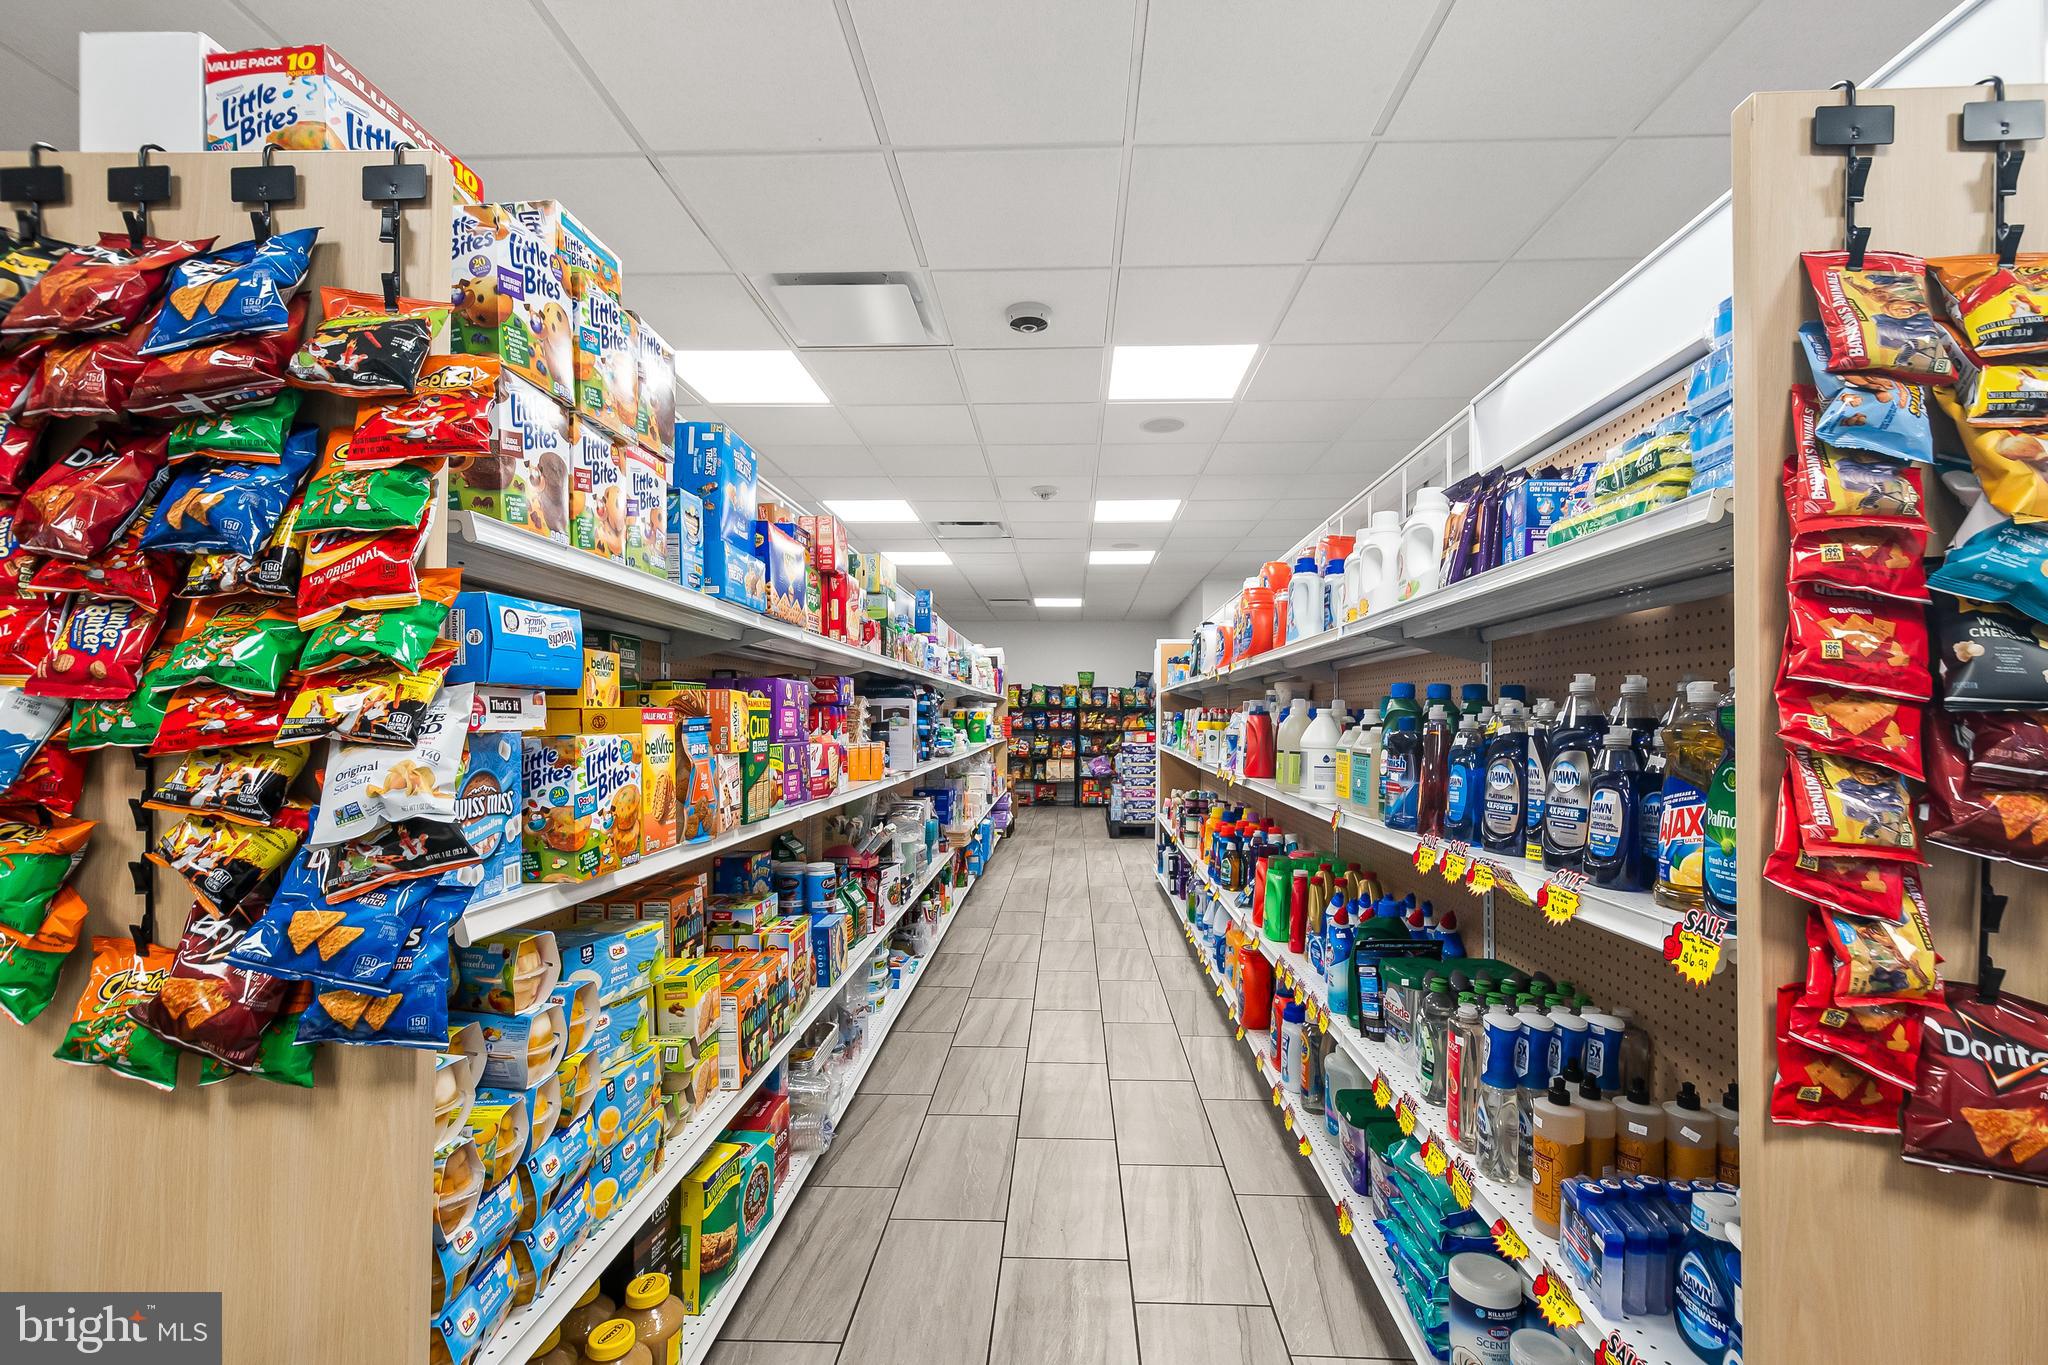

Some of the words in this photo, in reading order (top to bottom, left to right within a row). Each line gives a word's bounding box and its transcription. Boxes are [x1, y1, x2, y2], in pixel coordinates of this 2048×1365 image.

[208, 59, 247, 73] VALUE
[248, 55, 283, 69] PACK
[287, 51, 317, 71] 10
[222, 84, 277, 131] Little
[327, 50, 399, 121] VALUE
[402, 119, 452, 162] PACK
[240, 105, 298, 145] Bites
[452, 160, 478, 194] 10
[510, 233, 548, 270] Little
[564, 236, 583, 253] Little
[472, 258, 487, 268] 20
[570, 252, 590, 270] Bites
[524, 267, 561, 301] Bites
[1826, 271, 1848, 308] ANIMALS
[244, 297, 262, 306] 150
[590, 298, 620, 327] Little
[600, 326, 628, 351] Bites
[1838, 306, 1865, 358] BARNUM'S
[524, 424, 558, 450] Bites
[1802, 408, 1814, 449] ANIMALS
[583, 436, 609, 466] Little
[592, 461, 618, 485] Bites
[633, 472, 653, 495] Little
[640, 492, 660, 510] Bites
[223, 520, 239, 531] 150
[1998, 535, 2042, 555] Vinegar
[2002, 527, 2021, 538] Sea
[2023, 532, 2043, 546] Salt
[264, 562, 280, 572] 160
[325, 546, 379, 580] ORIGINAL
[83, 604, 110, 654] Butter
[103, 602, 135, 648] Nutter
[524, 617, 547, 628] Snacks
[591, 656, 615, 670] belVita
[491, 699, 507, 712] That's
[508, 699, 519, 711] it
[392, 714, 407, 723] 160
[750, 715, 769, 740] CLUB
[645, 733, 674, 756] belVita
[420, 749, 441, 762] 140
[650, 756, 671, 765] CRUNCHY
[335, 761, 379, 783] Original
[586, 743, 619, 787] Little
[333, 781, 349, 796] Sea
[350, 775, 372, 790] Salt
[530, 765, 573, 791] Bites
[599, 765, 630, 801] Bites
[1488, 771, 1514, 785] DAWN
[1552, 770, 1581, 787] DAWN
[552, 789, 565, 797] 20
[1488, 793, 1513, 801] PLATINUM
[1551, 796, 1579, 805] PLATINUM
[455, 796, 485, 821] WISS
[1487, 801, 1495, 809] 4X
[1495, 802, 1515, 812] POWER
[1549, 806, 1558, 815] 4X
[1558, 808, 1580, 819] POWER
[1591, 802, 1613, 815] DAWN
[1659, 805, 1705, 847] AJAX
[1707, 808, 1736, 830] Palmo
[1422, 833, 1441, 850] SALE
[1448, 840, 1471, 858] SALE
[1723, 858, 1728, 868] &
[1551, 868, 1590, 893] SALE
[1682, 908, 1728, 944] SALE
[582, 946, 593, 957] 12
[612, 946, 625, 957] Dole
[360, 956, 378, 967] 150
[610, 963, 628, 974] diced
[610, 971, 629, 985] pears
[552, 996, 564, 1006] Dole
[1382, 997, 1411, 1022] ascade
[411, 1017, 427, 1026] 150
[594, 1033, 610, 1047] diced
[1518, 1042, 1527, 1057] 5X
[1551, 1042, 1560, 1057] 5X
[1589, 1043, 1602, 1058] 5X
[1944, 1027, 2048, 1075] Dorito
[607, 1082, 614, 1093] 12
[626, 1076, 636, 1089] Dole
[562, 1140, 575, 1154] diced
[624, 1142, 635, 1157] Dole
[545, 1158, 558, 1172] Dole
[603, 1154, 611, 1166] 12
[1453, 1154, 1477, 1187] SALE
[573, 1187, 583, 1199] added
[479, 1206, 494, 1224] diced
[481, 1210, 503, 1234] peaches
[560, 1210, 572, 1226] diced
[457, 1229, 473, 1250] Dole
[527, 1235, 533, 1244] 4
[542, 1230, 555, 1247] Dole
[480, 1285, 494, 1303] diced
[1682, 1271, 1713, 1305] DAWN
[444, 1319, 450, 1329] 4
[462, 1310, 477, 1331] Dole
